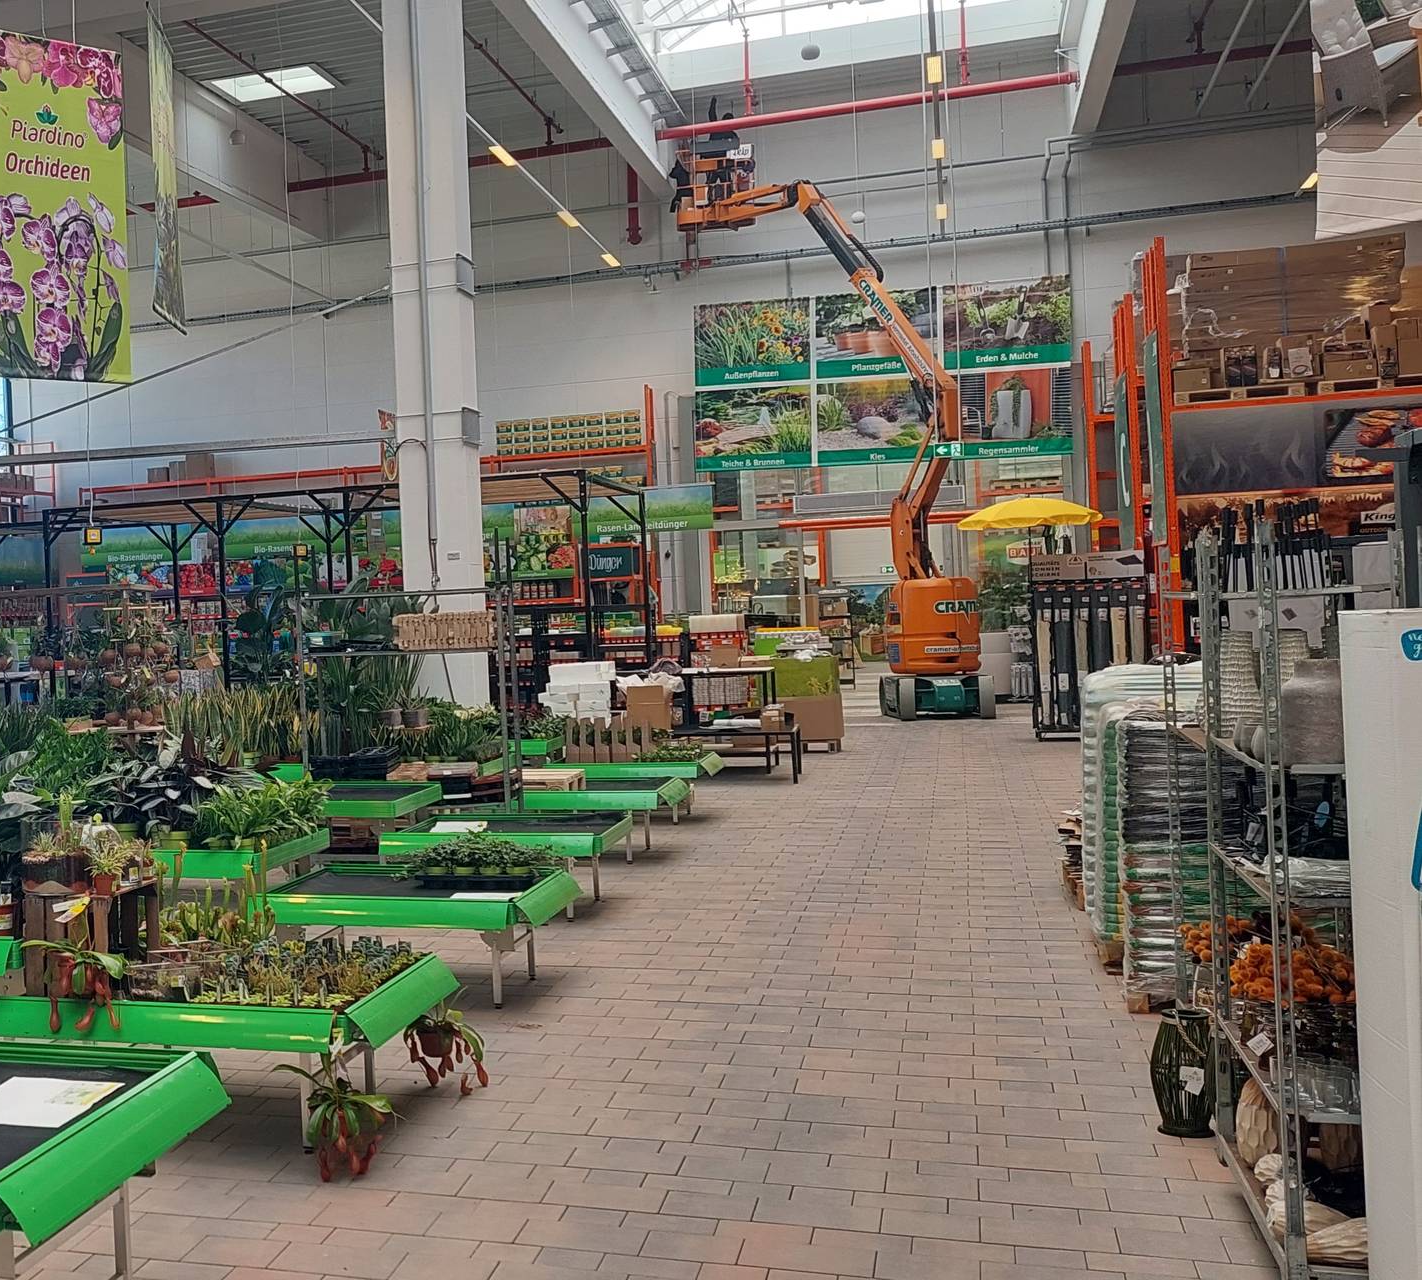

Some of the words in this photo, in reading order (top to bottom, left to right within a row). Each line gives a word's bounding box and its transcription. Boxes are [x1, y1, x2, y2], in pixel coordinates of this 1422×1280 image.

[5, 151, 91, 183] Orchideen
[859, 279, 893, 322] CRAMER
[975, 354, 999, 363] Erden
[1000, 353, 1008, 361] &
[1009, 351, 1039, 361] Mulche
[851, 361, 902, 372] Pflanzgefäße
[724, 370, 779, 380] Außenpflanzen
[869, 452, 886, 461] Kies
[978, 446, 1040, 456] Regensammler
[721, 460, 744, 468] Teiche
[745, 459, 752, 467] &
[753, 458, 785, 467] Brunnen
[108, 553, 163, 562] Bio-Rasendünger
[589, 553, 623, 573] Dünger
[934, 601, 979, 615] CRAM
